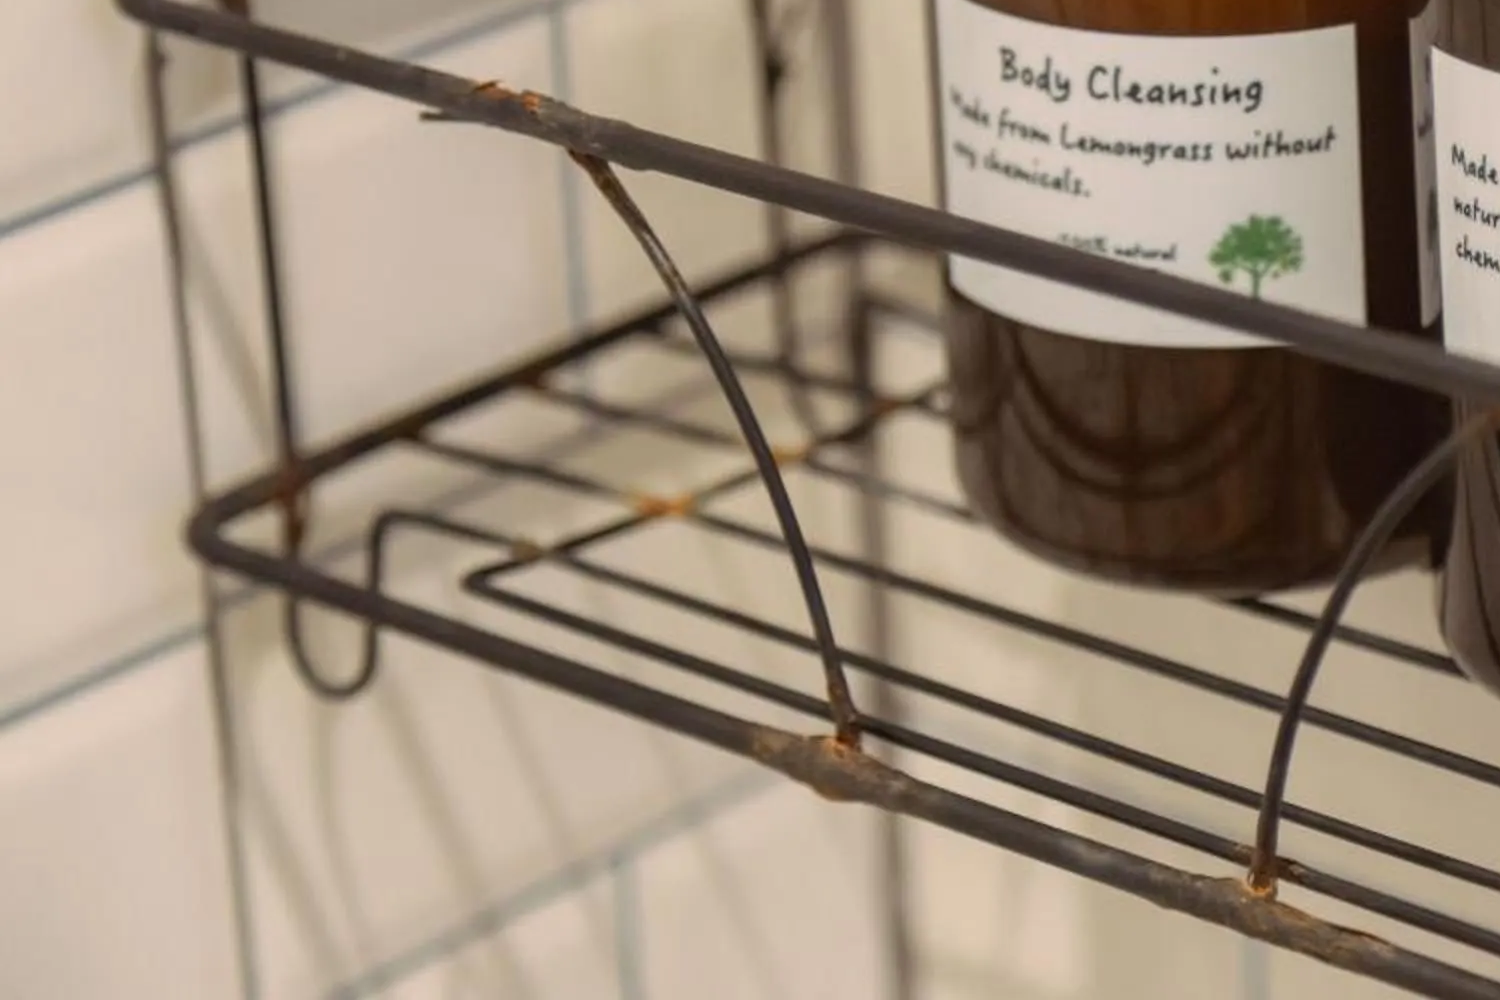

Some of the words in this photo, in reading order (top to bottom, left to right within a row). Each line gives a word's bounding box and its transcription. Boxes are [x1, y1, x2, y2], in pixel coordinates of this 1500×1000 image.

[1000, 47, 1070, 102] Body
[1087, 66, 1264, 114] Cleansing
[998, 107, 1051, 140] from
[1060, 122, 1213, 166] Lemongrass
[1225, 125, 1338, 161] without
[983, 149, 1091, 197] chemicals.
[1451, 144, 1499, 186] Made
[1114, 242, 1177, 262] natural
